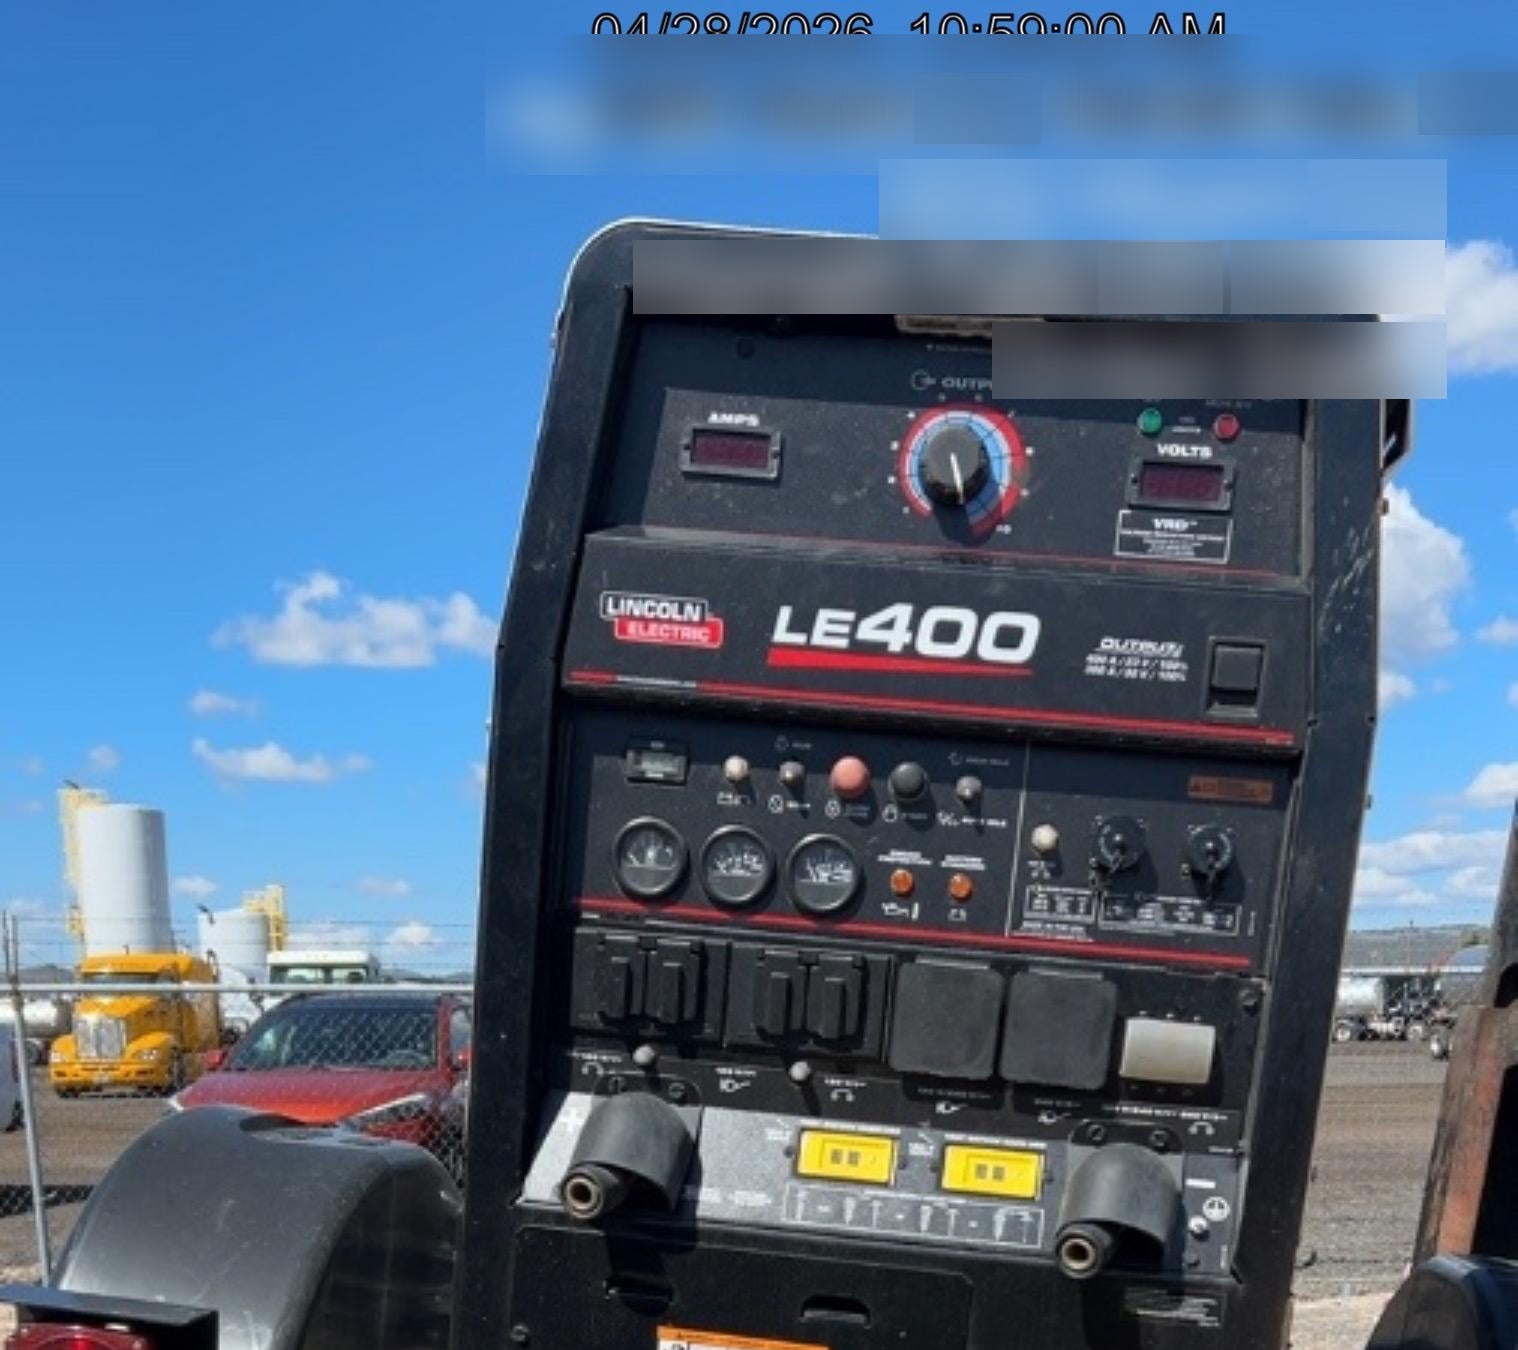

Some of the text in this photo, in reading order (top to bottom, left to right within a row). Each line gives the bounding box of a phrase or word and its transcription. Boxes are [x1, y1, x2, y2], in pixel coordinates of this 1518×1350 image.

[941, 376, 992, 391] OUTP
[708, 411, 760, 427] AMPS
[1157, 443, 1213, 458] VOLTS
[606, 596, 702, 622] LINCOLN
[626, 622, 711, 643] ELECTRIC
[771, 602, 1041, 664] LE400
